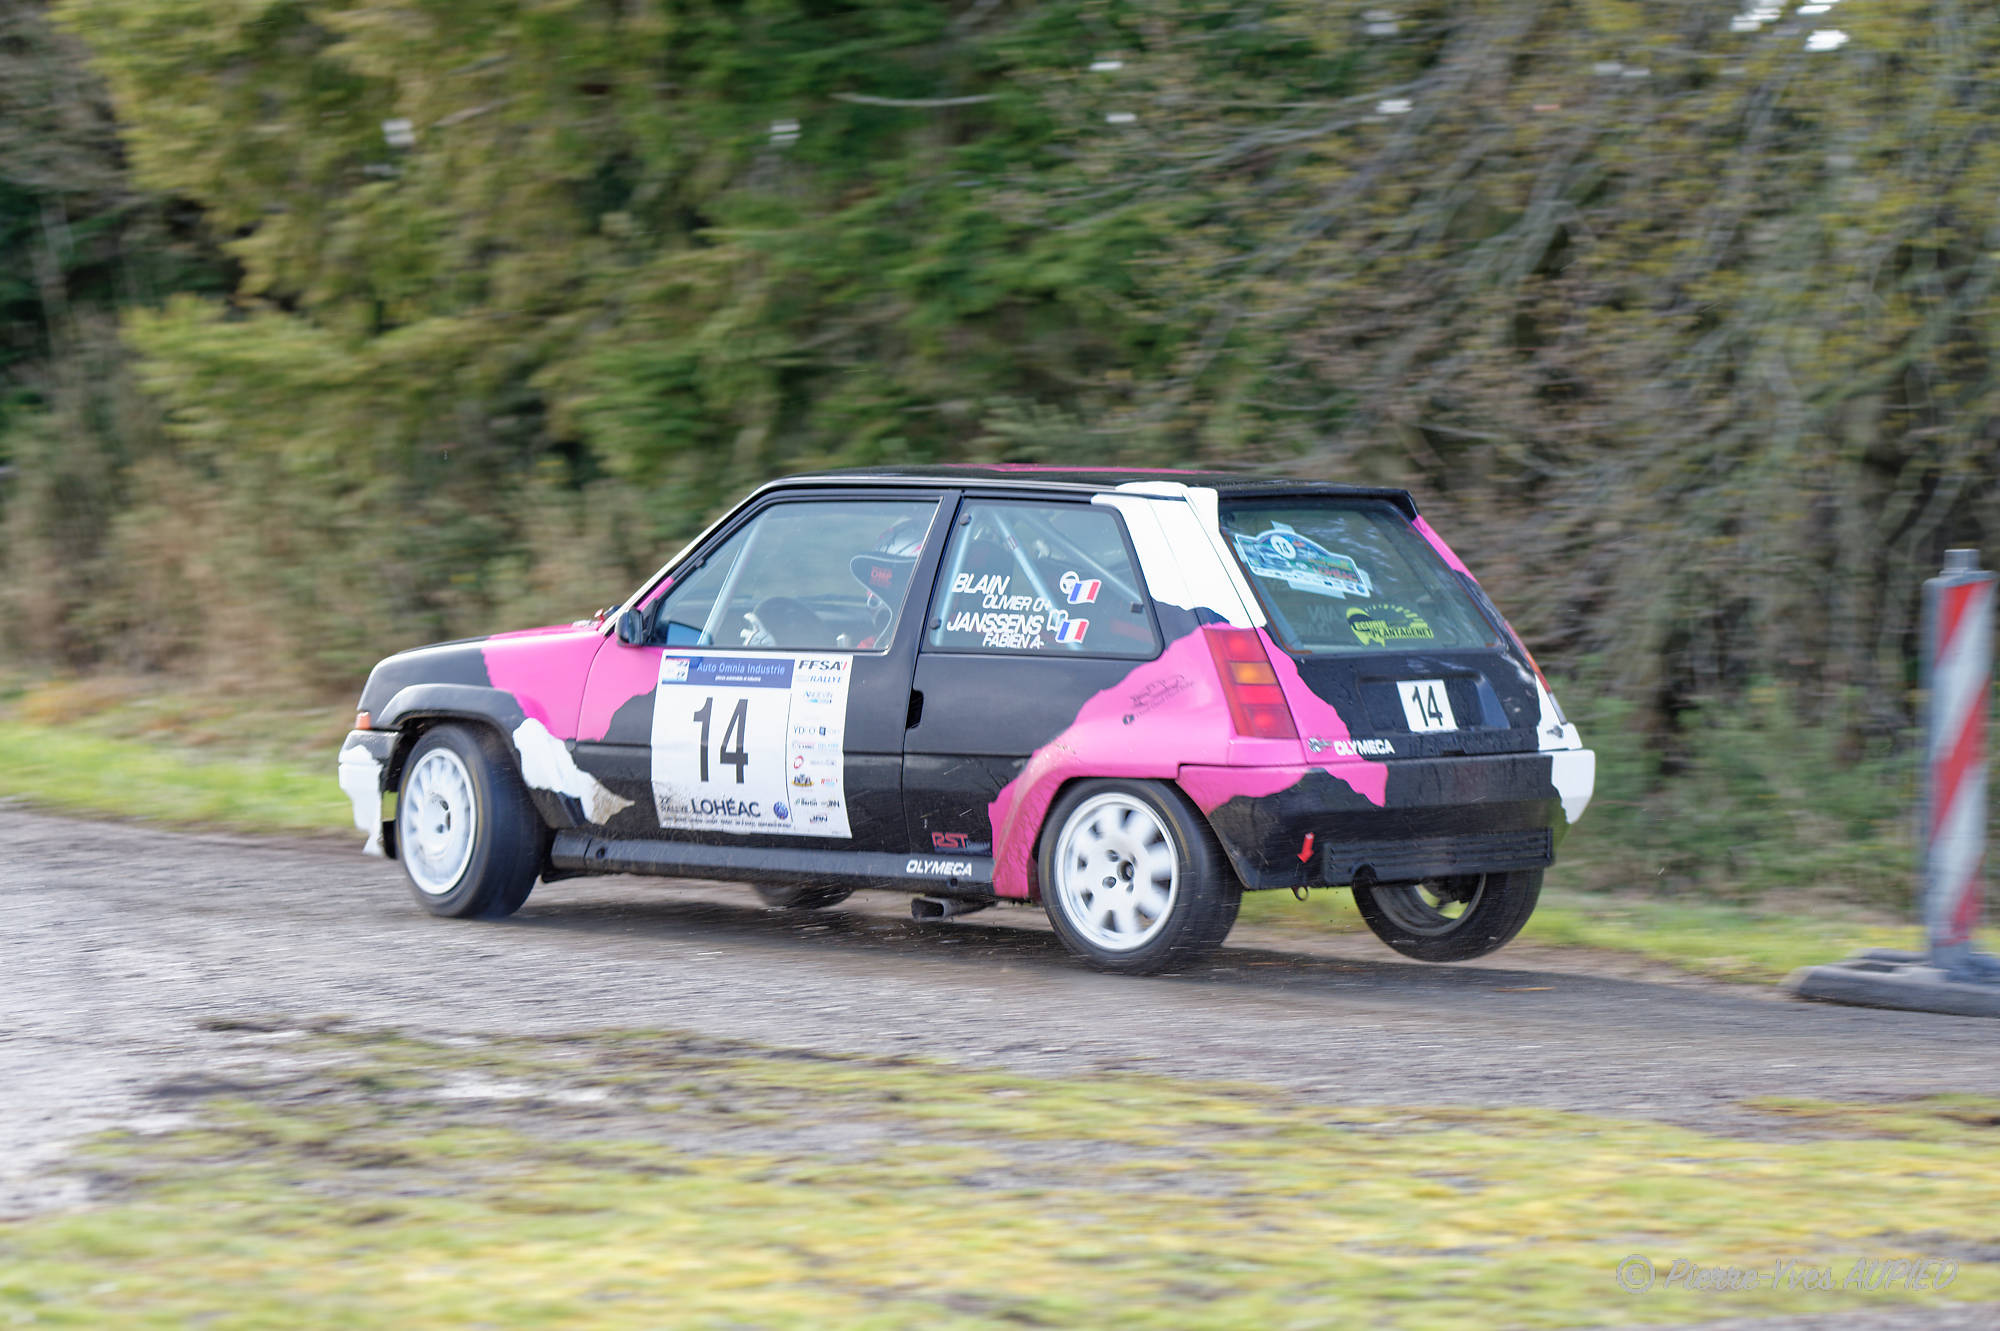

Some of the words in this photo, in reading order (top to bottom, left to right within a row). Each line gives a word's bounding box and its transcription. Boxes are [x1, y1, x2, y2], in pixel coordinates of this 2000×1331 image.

[1276, 541, 1292, 554] 14
[952, 573, 1010, 596] BLAIN
[982, 594, 1033, 611] OLIVIER
[947, 611, 1045, 635] JANSSENS
[982, 632, 1029, 649] FABIEN
[697, 662, 717, 673] Auto
[719, 662, 745, 673] Omnia
[747, 662, 786, 675] Industrie
[798, 660, 841, 671] FFSA
[1411, 685, 1443, 727] 14
[693, 697, 749, 784] 14
[691, 797, 761, 818] LOHÉAC
[931, 831, 968, 848] RST
[905, 859, 972, 876] OLYMECA
